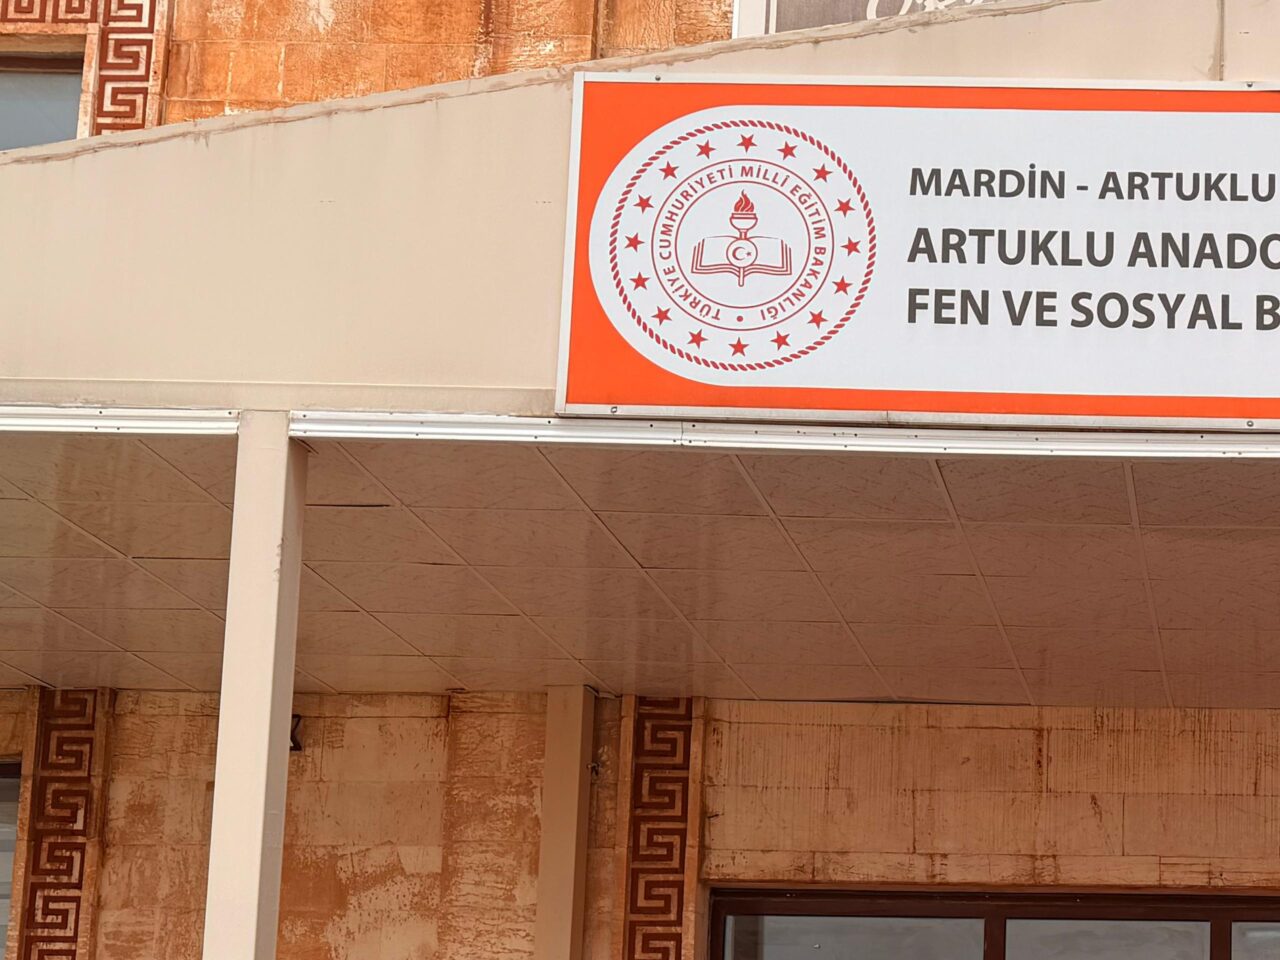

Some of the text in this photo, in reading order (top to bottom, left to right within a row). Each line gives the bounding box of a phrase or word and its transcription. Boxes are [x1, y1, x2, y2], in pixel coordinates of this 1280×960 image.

[910, 164, 1065, 198] MARDİN
[1099, 172, 1275, 202] ARTUKLU
[659, 165, 733, 260] CUMHURİYETİ
[790, 184, 826, 240] EĞİTİM
[908, 228, 1114, 267] ARTUKLU
[663, 265, 721, 320] TÜRKİYE
[760, 247, 827, 321] BAKANLIĞI
[908, 289, 989, 325] FEN
[1003, 291, 1057, 326] VE
[1071, 292, 1242, 329] SOSYAL
